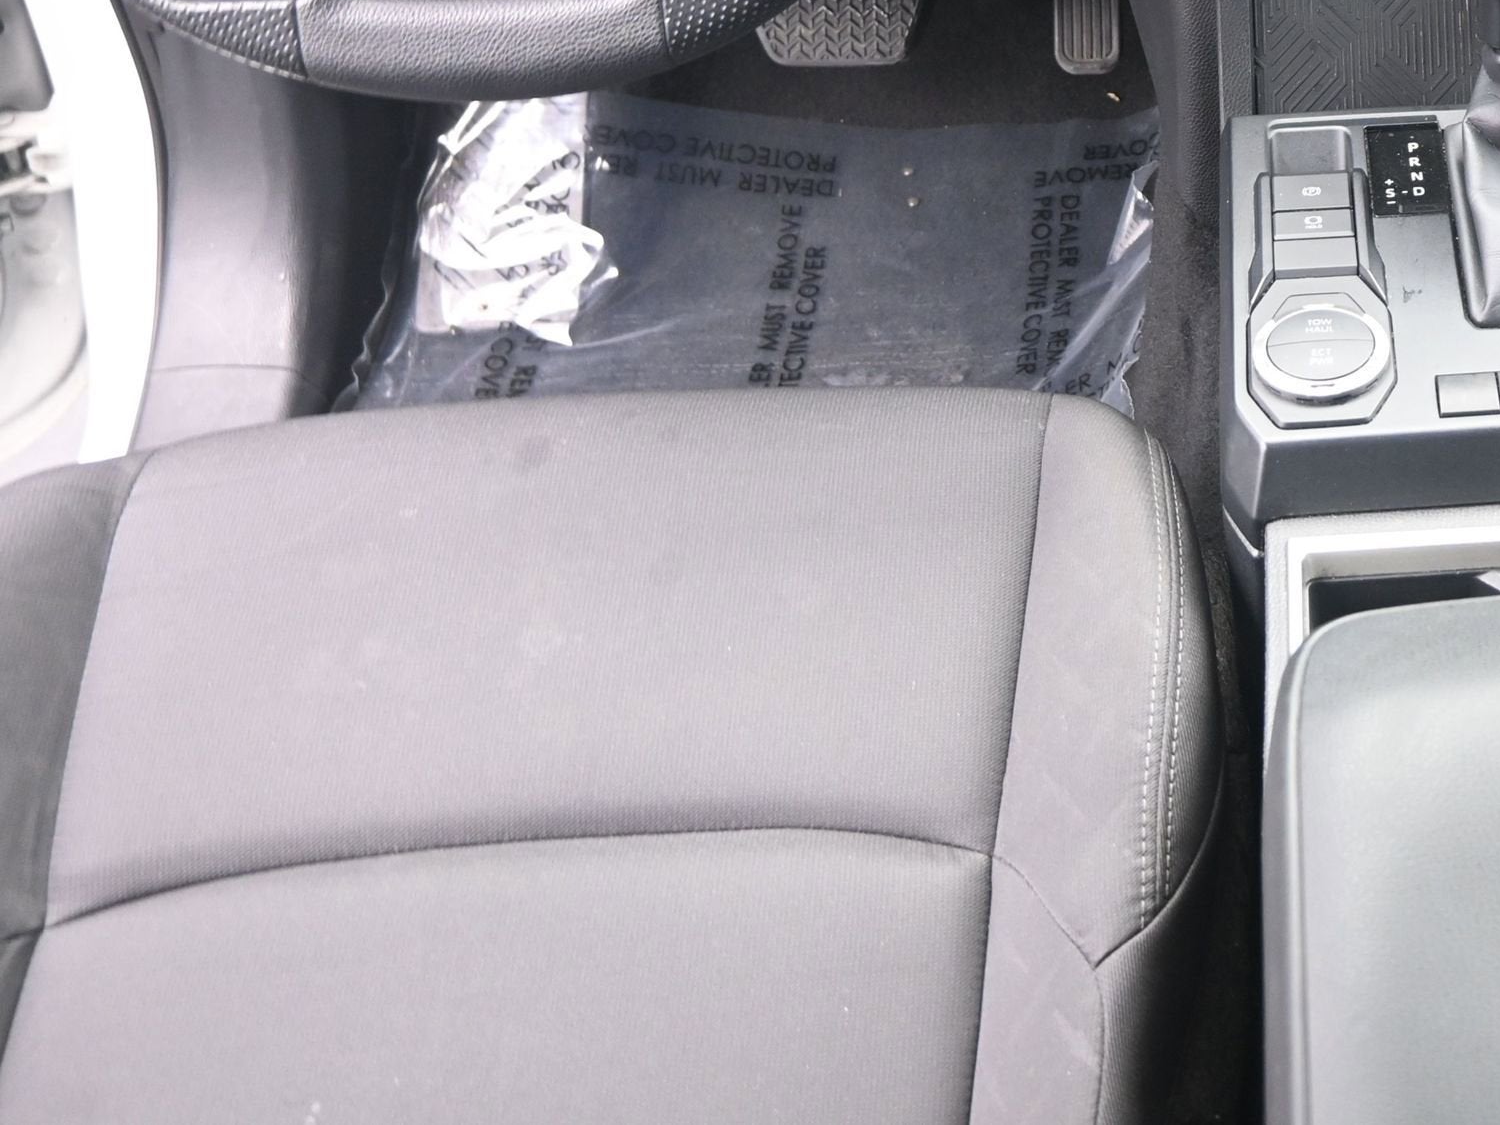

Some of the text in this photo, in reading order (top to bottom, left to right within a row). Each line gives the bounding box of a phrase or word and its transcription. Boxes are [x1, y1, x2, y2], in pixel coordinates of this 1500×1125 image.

[683, 136, 837, 173] PROTECTIVE
[1407, 142, 1419, 153] P
[1408, 157, 1421, 167] R
[655, 162, 721, 188] MUST
[738, 171, 834, 197] DEALER
[1385, 186, 1425, 198] S D
[1410, 171, 1424, 181] N
[769, 204, 803, 291] REMOVE
[1058, 194, 1081, 268] DEALER
[1015, 195, 1053, 376] PROTECTIVE COVER
[1051, 278, 1076, 318] MUST
[757, 302, 787, 352] MUST
[777, 246, 828, 387] TECTIVE COVER
[1307, 318, 1333, 326] TOW
[475, 336, 513, 400] COVE
